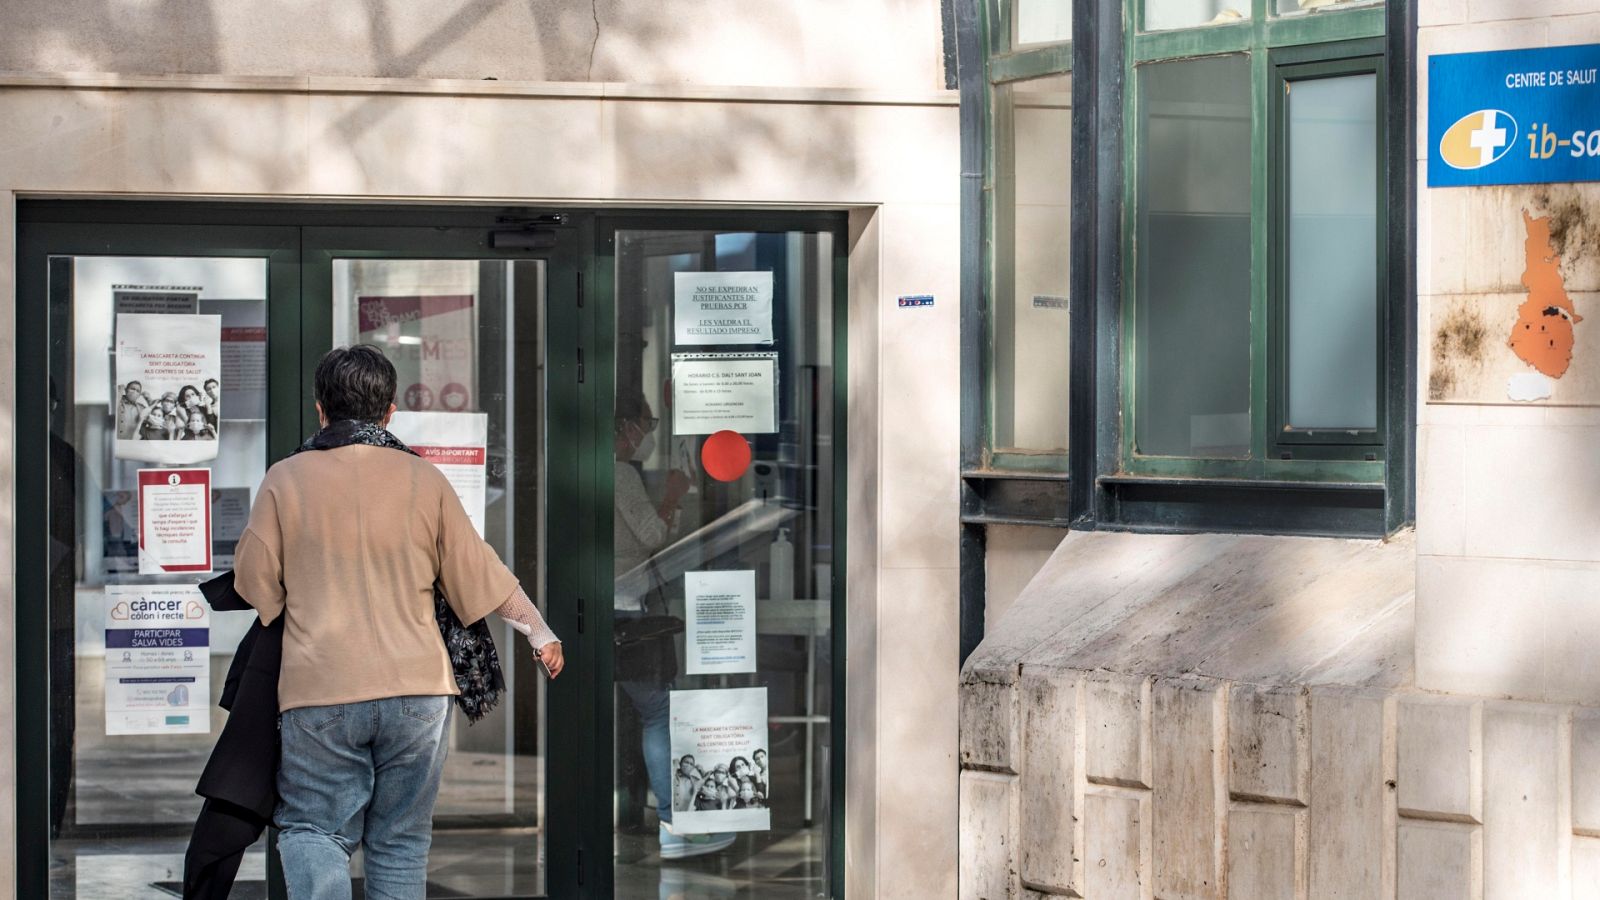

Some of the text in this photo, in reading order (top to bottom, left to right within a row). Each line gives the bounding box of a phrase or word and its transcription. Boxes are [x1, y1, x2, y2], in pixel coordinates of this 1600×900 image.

[1505, 68, 1597, 88] CENTRE DE SALUT
[130, 597, 182, 611] càncer
[162, 612, 184, 620] recte
[134, 630, 181, 638] PARTICIPAR
[132, 638, 183, 647] SALVA VIDES
